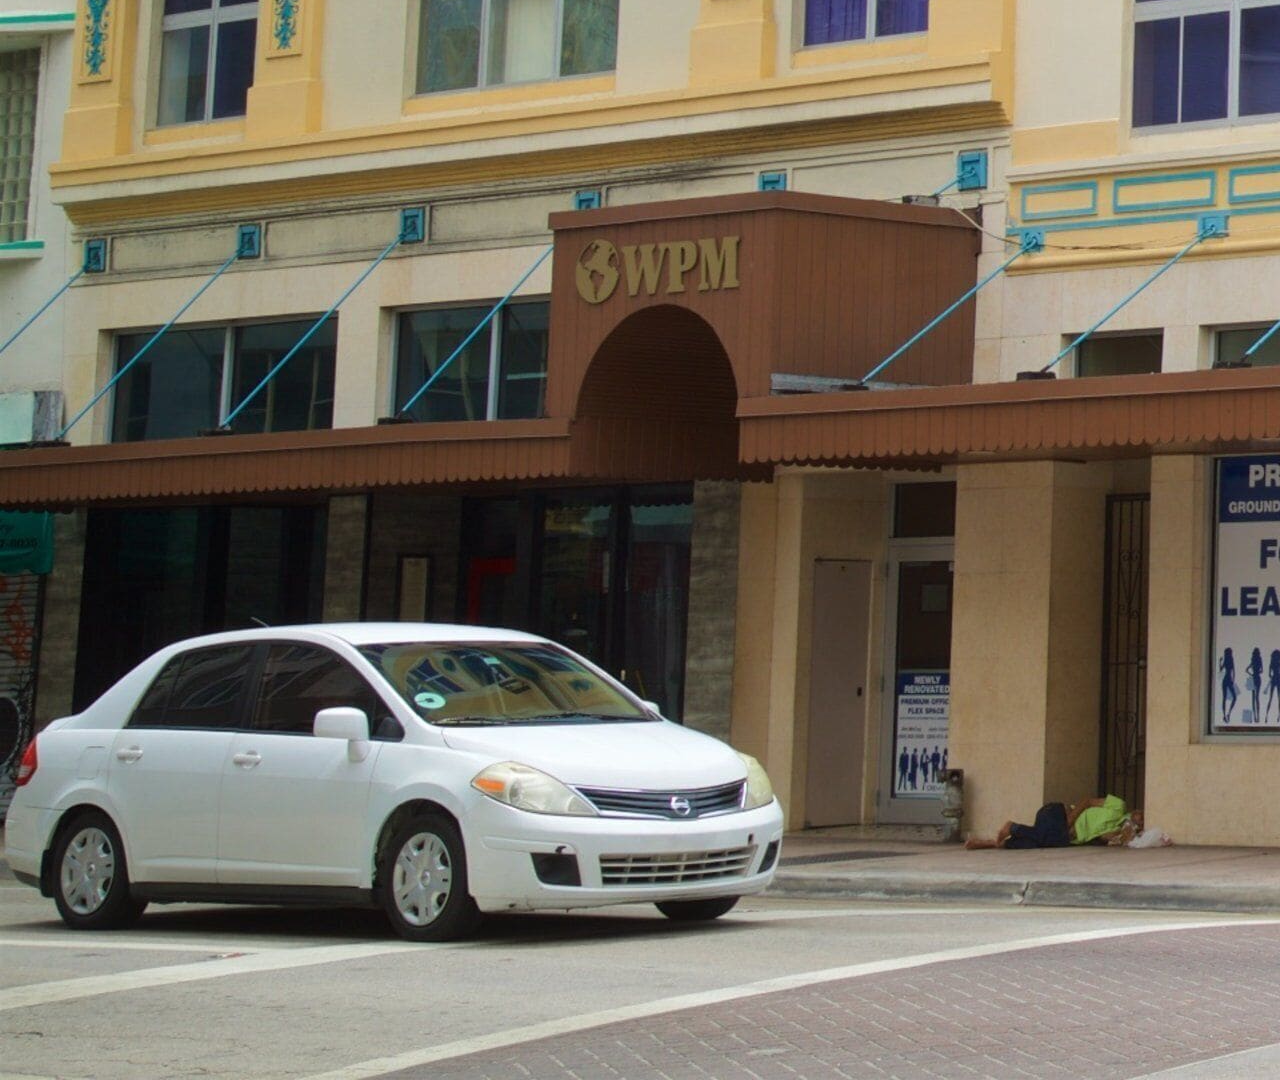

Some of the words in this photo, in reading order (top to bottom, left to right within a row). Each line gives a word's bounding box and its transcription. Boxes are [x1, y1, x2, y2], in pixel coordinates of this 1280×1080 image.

[621, 235, 740, 297] WPM
[1228, 500, 1280, 514] GROUND
[914, 675, 942, 685] NEWLY
[904, 684, 950, 694] RENOVATED
